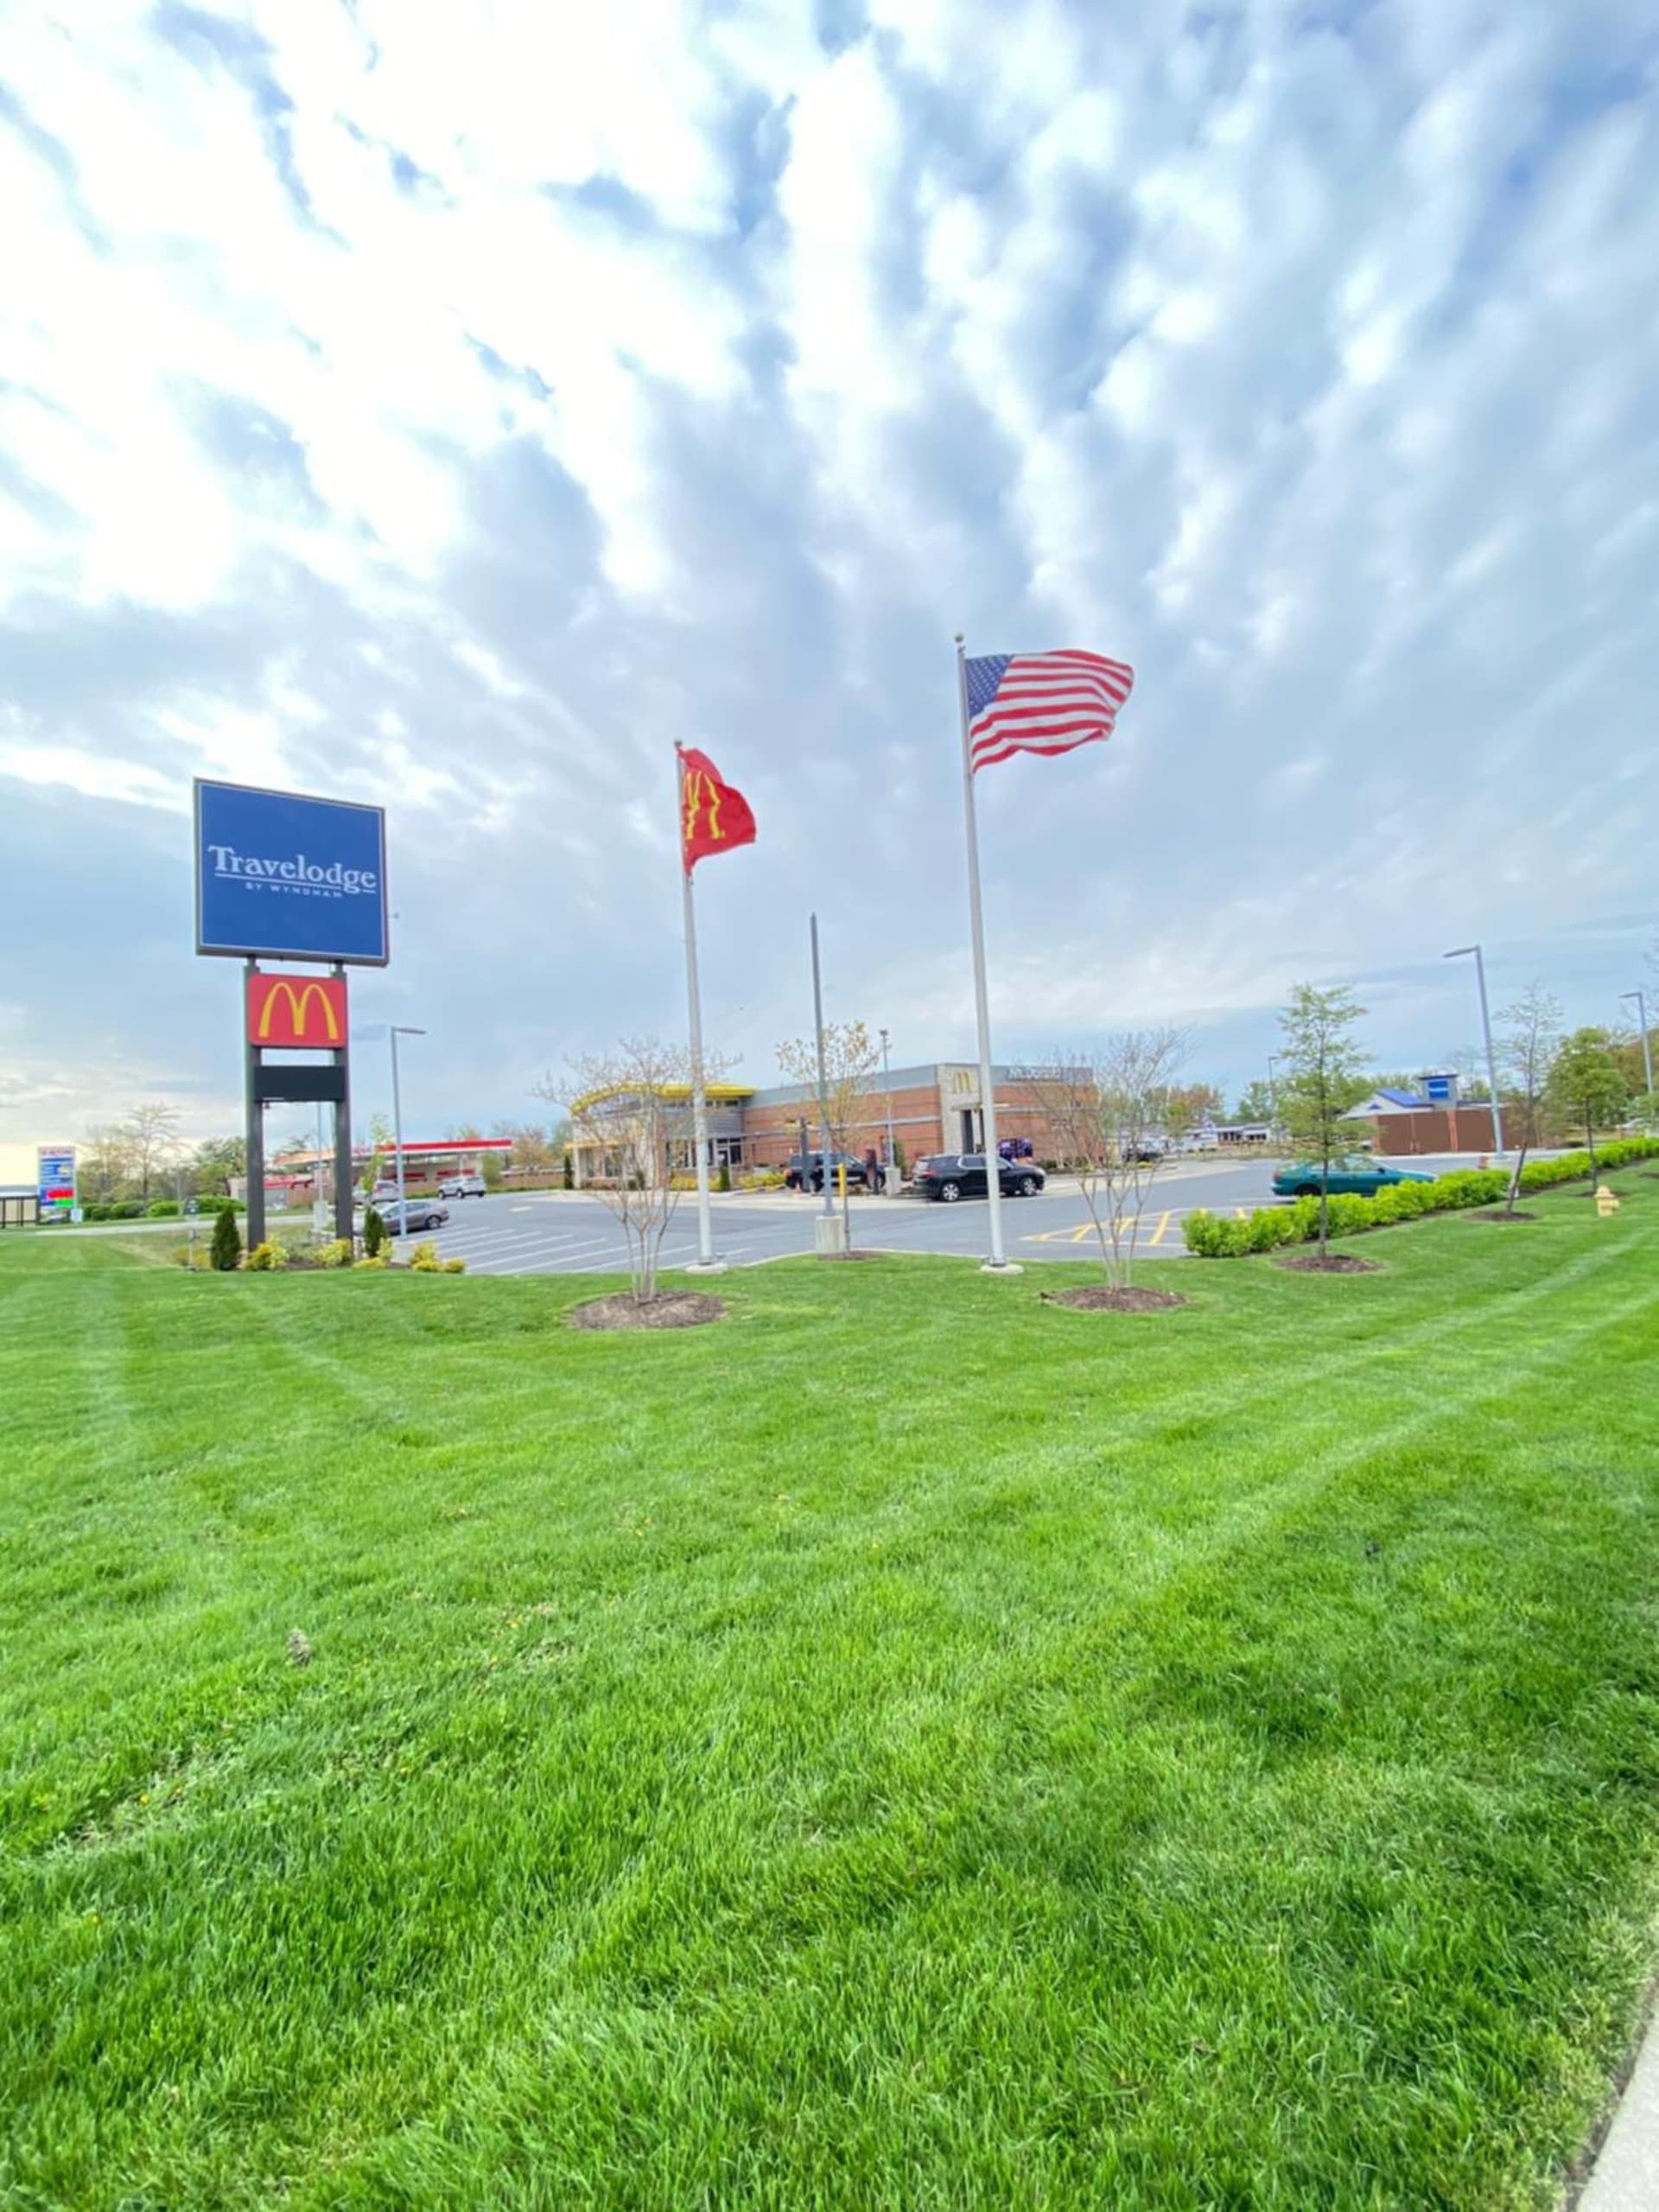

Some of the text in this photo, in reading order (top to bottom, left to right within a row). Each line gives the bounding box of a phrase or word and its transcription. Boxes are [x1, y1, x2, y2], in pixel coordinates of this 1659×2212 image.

[208, 845, 376, 894] Travelodge
[245, 882, 342, 898] BY WYNDHAM
